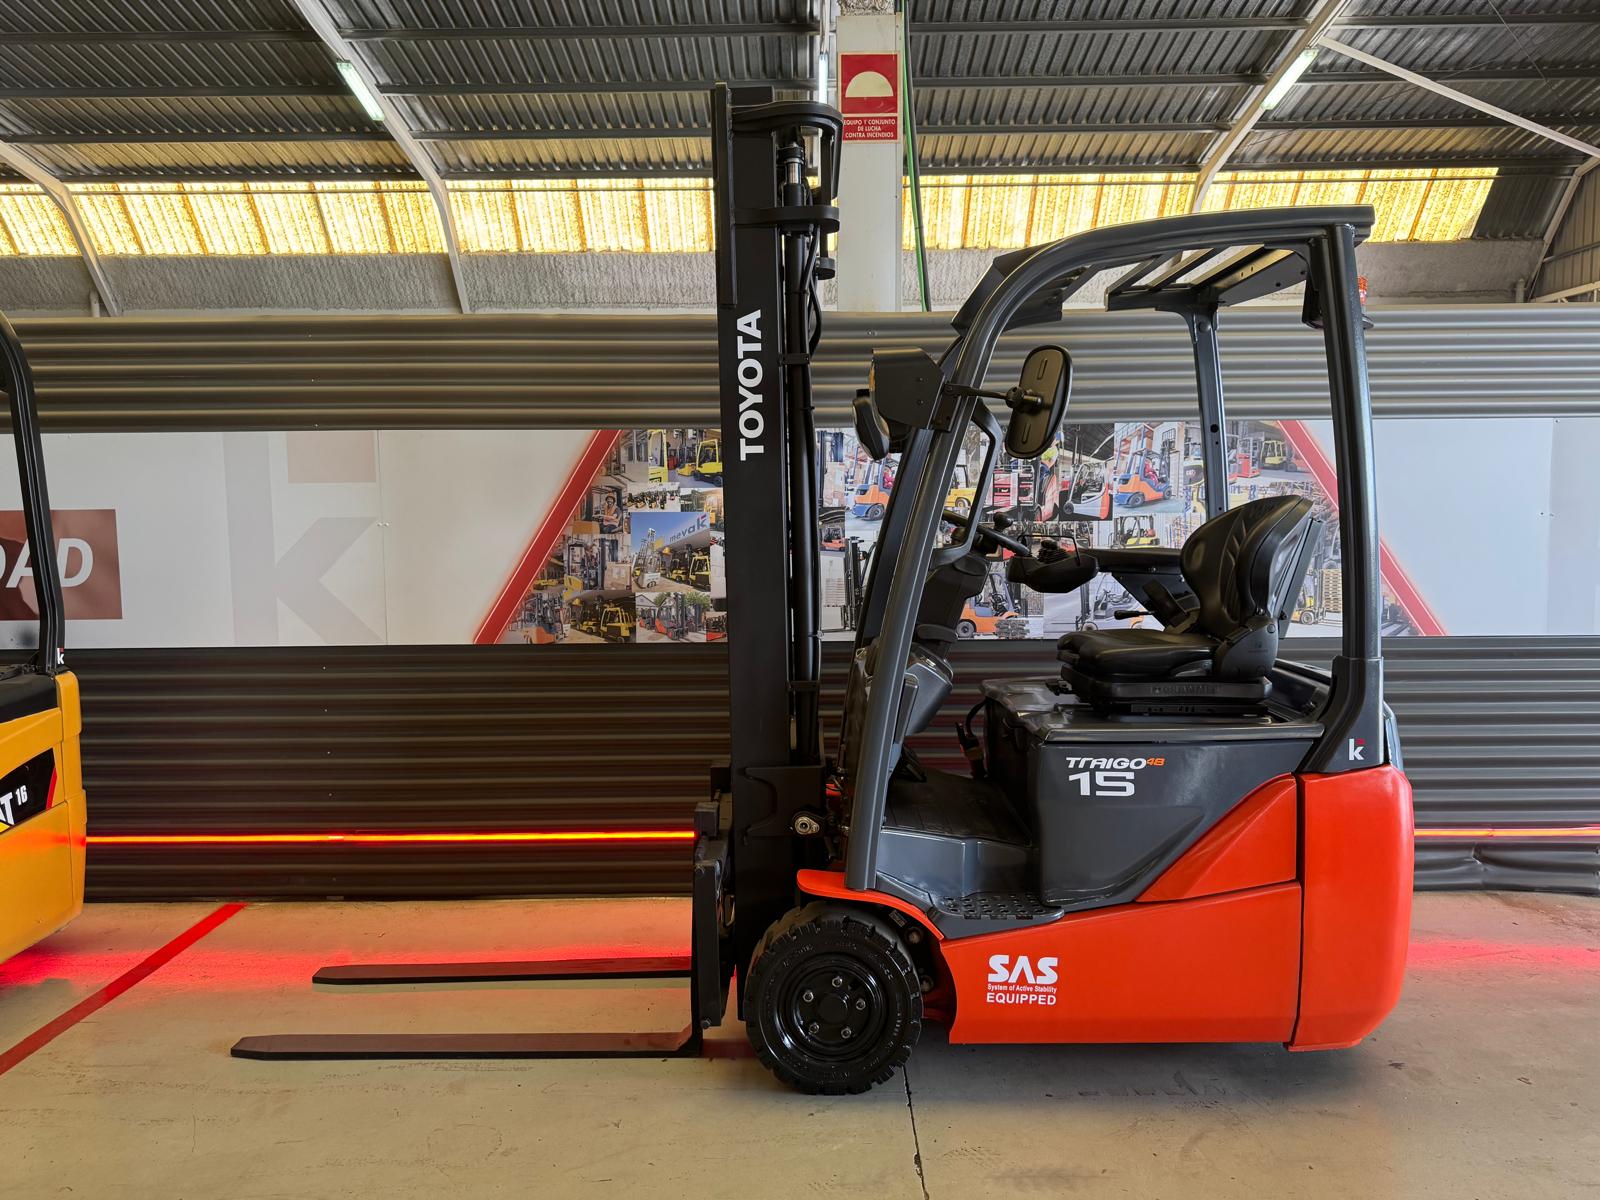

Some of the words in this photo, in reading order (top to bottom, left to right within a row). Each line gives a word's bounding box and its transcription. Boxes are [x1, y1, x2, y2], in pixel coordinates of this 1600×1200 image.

[736, 309, 765, 461] TOYOTA
[57, 648, 65, 665] k
[1348, 738, 1365, 761] k
[1068, 771, 1135, 797] 15
[15, 785, 28, 806] 16
[988, 954, 1059, 985] SAS
[986, 992, 1056, 1005] EQUIPPED
[987, 983, 1008, 992] System
[1034, 986, 1057, 994] Stability
